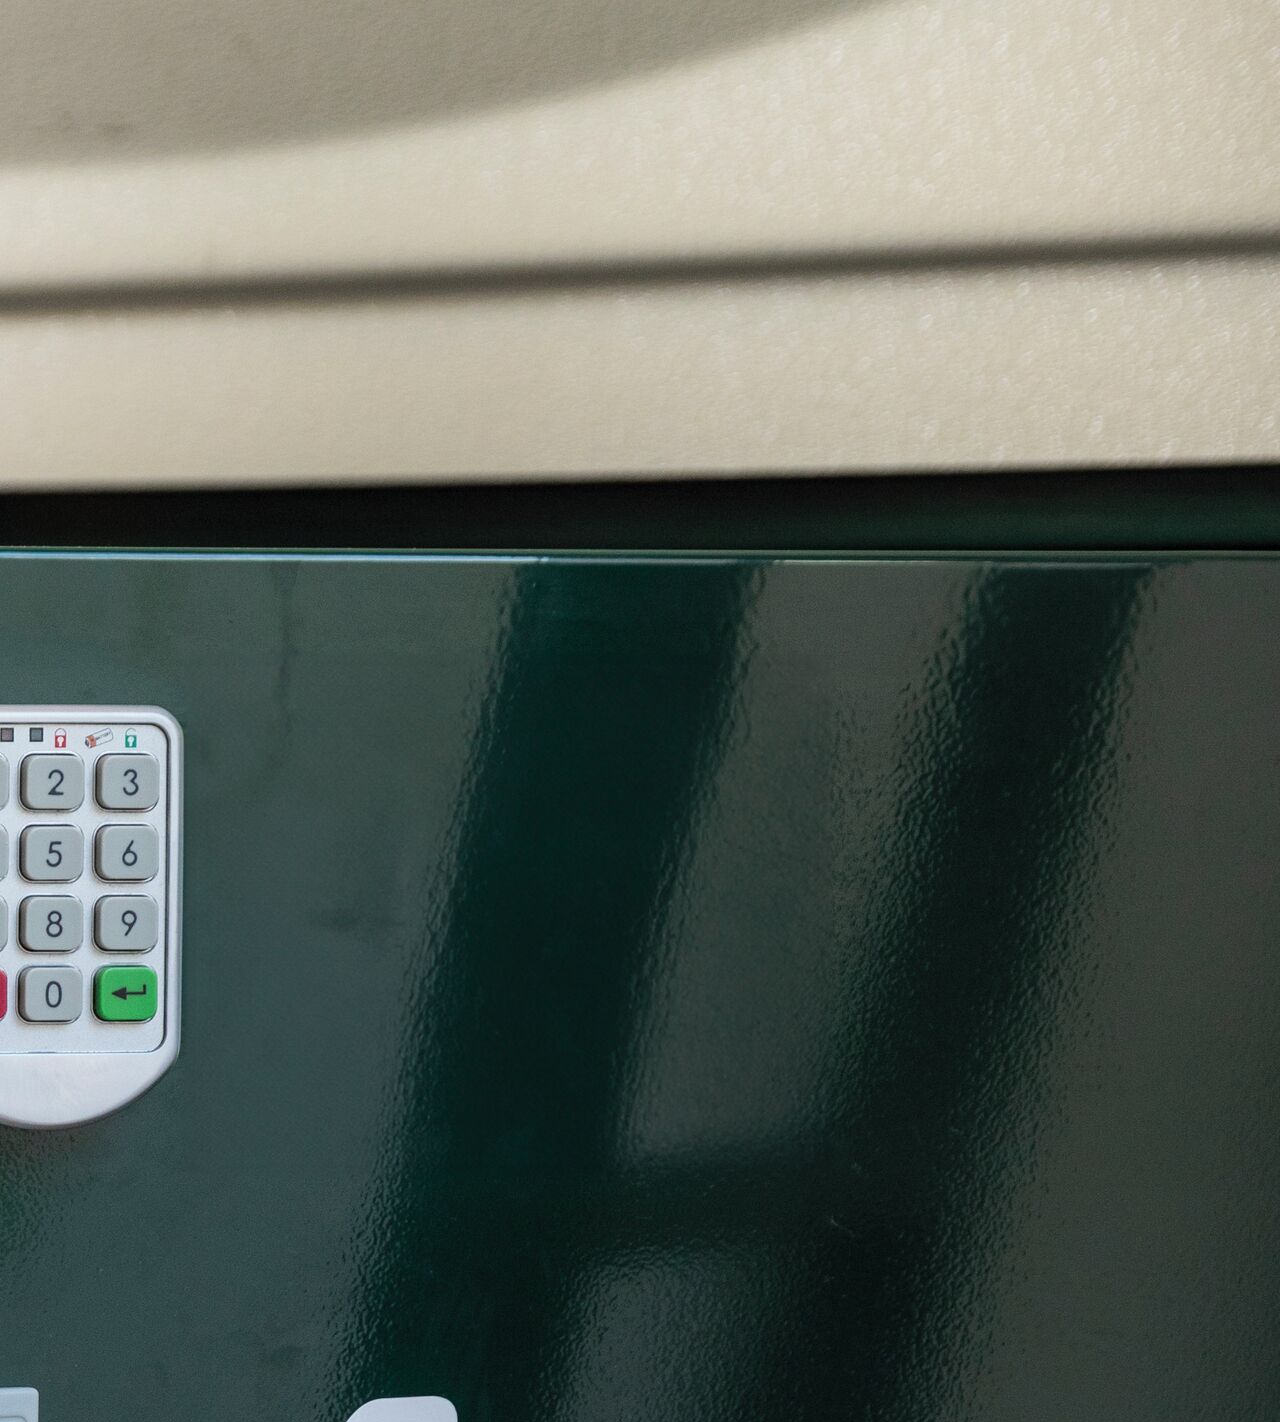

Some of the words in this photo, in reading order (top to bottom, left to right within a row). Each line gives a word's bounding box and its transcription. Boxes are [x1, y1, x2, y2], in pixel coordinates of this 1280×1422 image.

[47, 769, 65, 796] 2
[122, 768, 139, 796] 3
[46, 840, 63, 868] 5
[121, 839, 138, 867] 6
[45, 910, 63, 938] 8
[121, 910, 138, 937] 9
[45, 980, 63, 1009] 0
